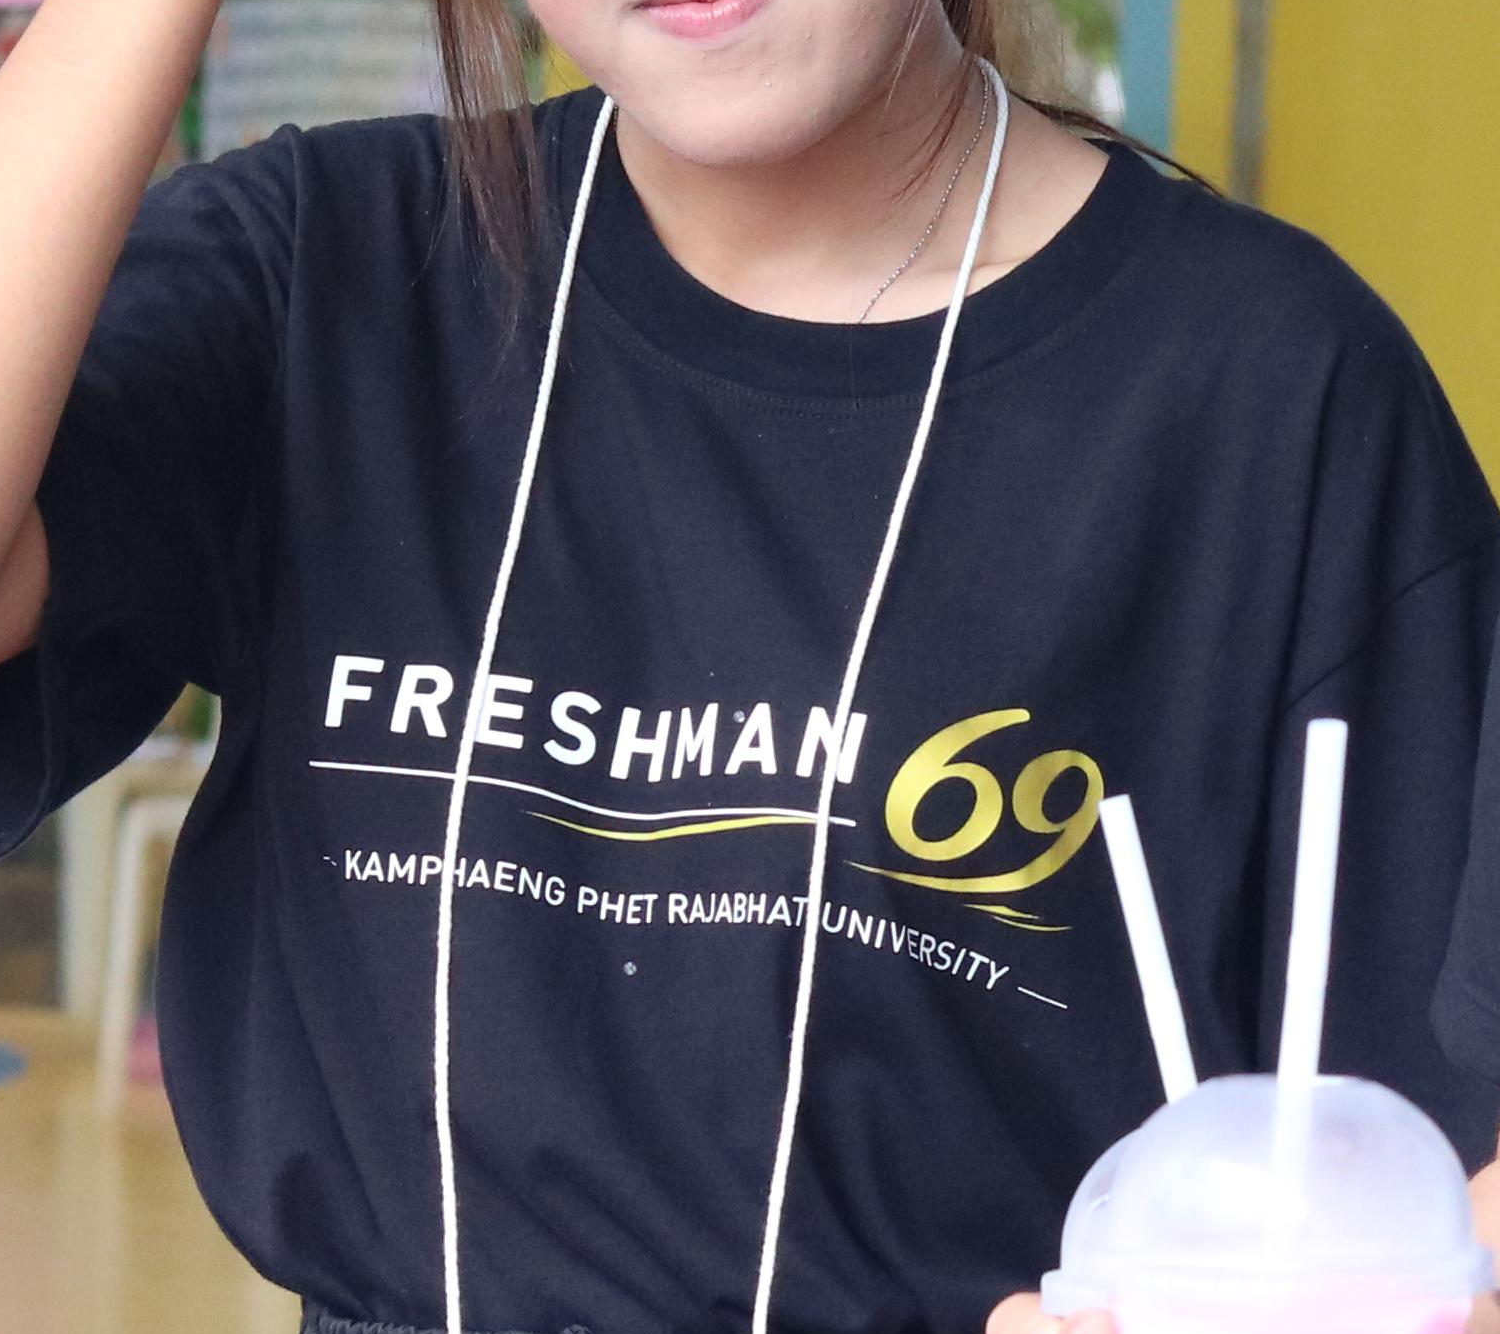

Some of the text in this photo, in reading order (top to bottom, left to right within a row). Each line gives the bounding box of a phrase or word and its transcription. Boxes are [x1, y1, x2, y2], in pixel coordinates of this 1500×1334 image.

[324, 654, 1104, 894] FRESHMAN 69
[344, 849, 1010, 990] KAMPHAENG PHET RAJABHAT UNIVERSITY
